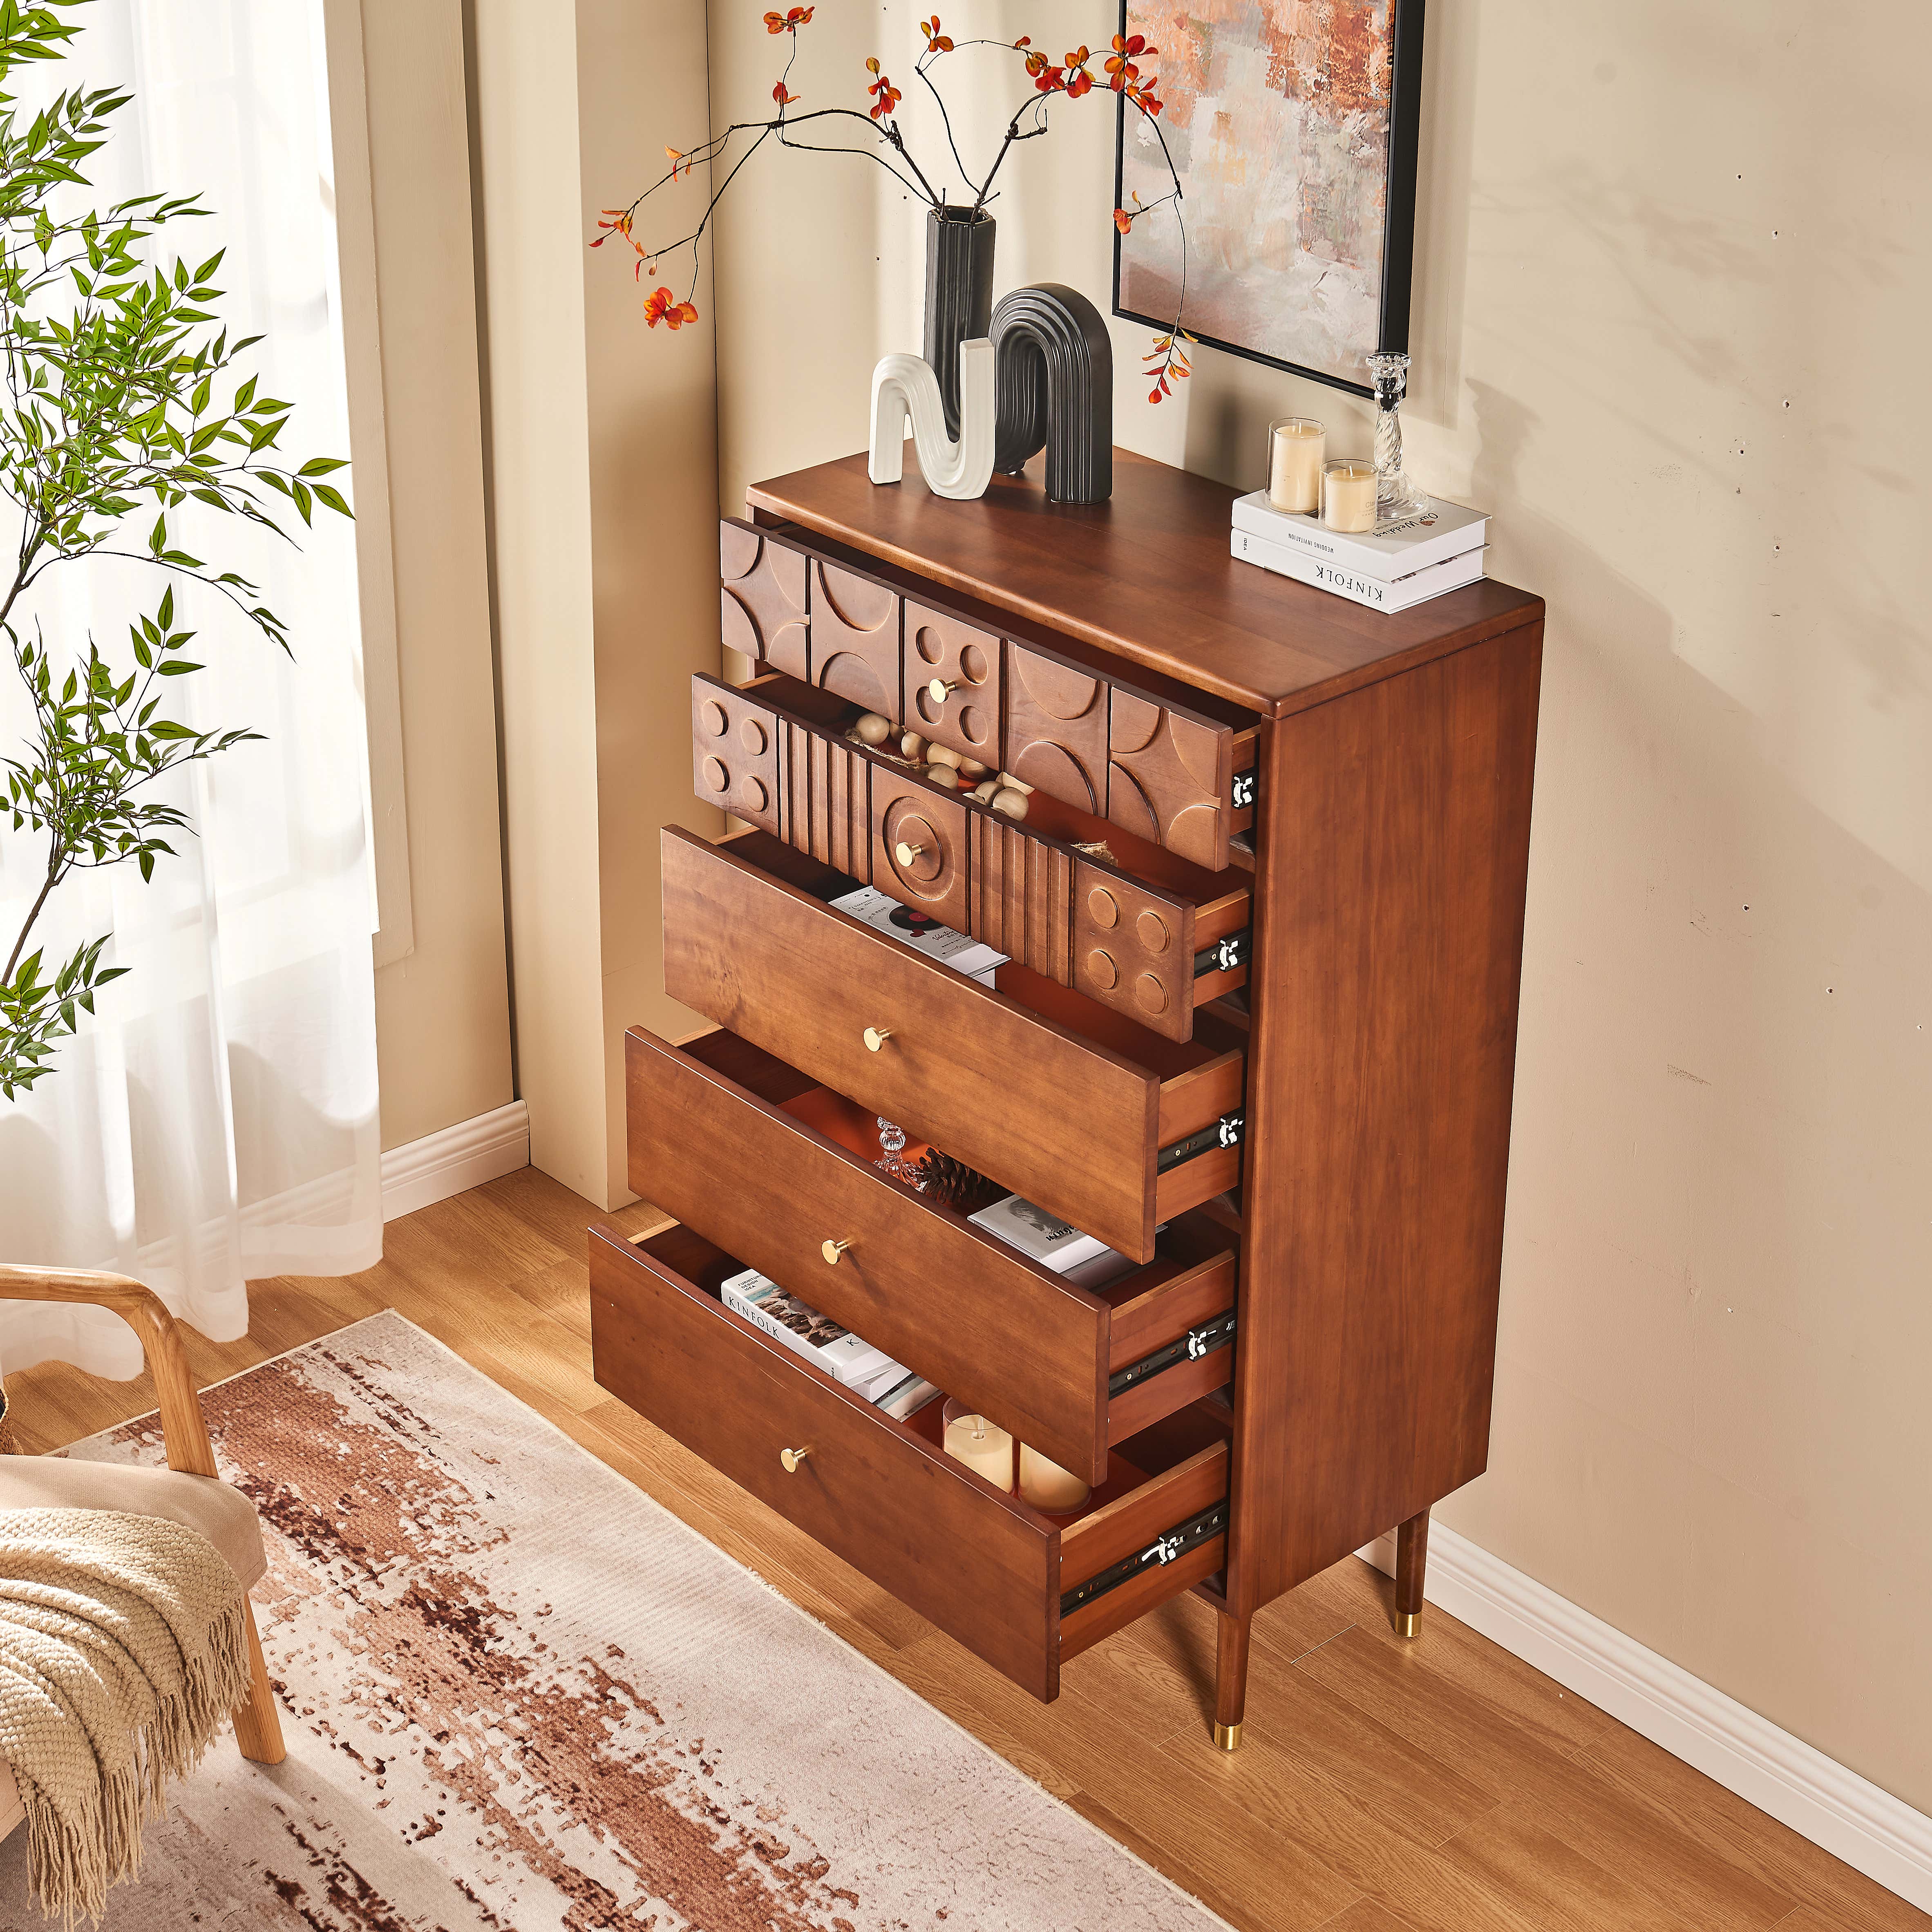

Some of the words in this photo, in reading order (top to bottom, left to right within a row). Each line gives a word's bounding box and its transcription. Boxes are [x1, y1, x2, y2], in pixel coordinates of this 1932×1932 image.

[1419, 512, 1438, 521] Our
[1372, 520, 1420, 537] Wedding
[1288, 533, 1313, 547] INVITATION
[1313, 541, 1334, 554] WEDDING
[1315, 565, 1382, 601] KINFOLK
[741, 1279, 759, 1289] DESIGN
[729, 1296, 780, 1339] KINFOLK
